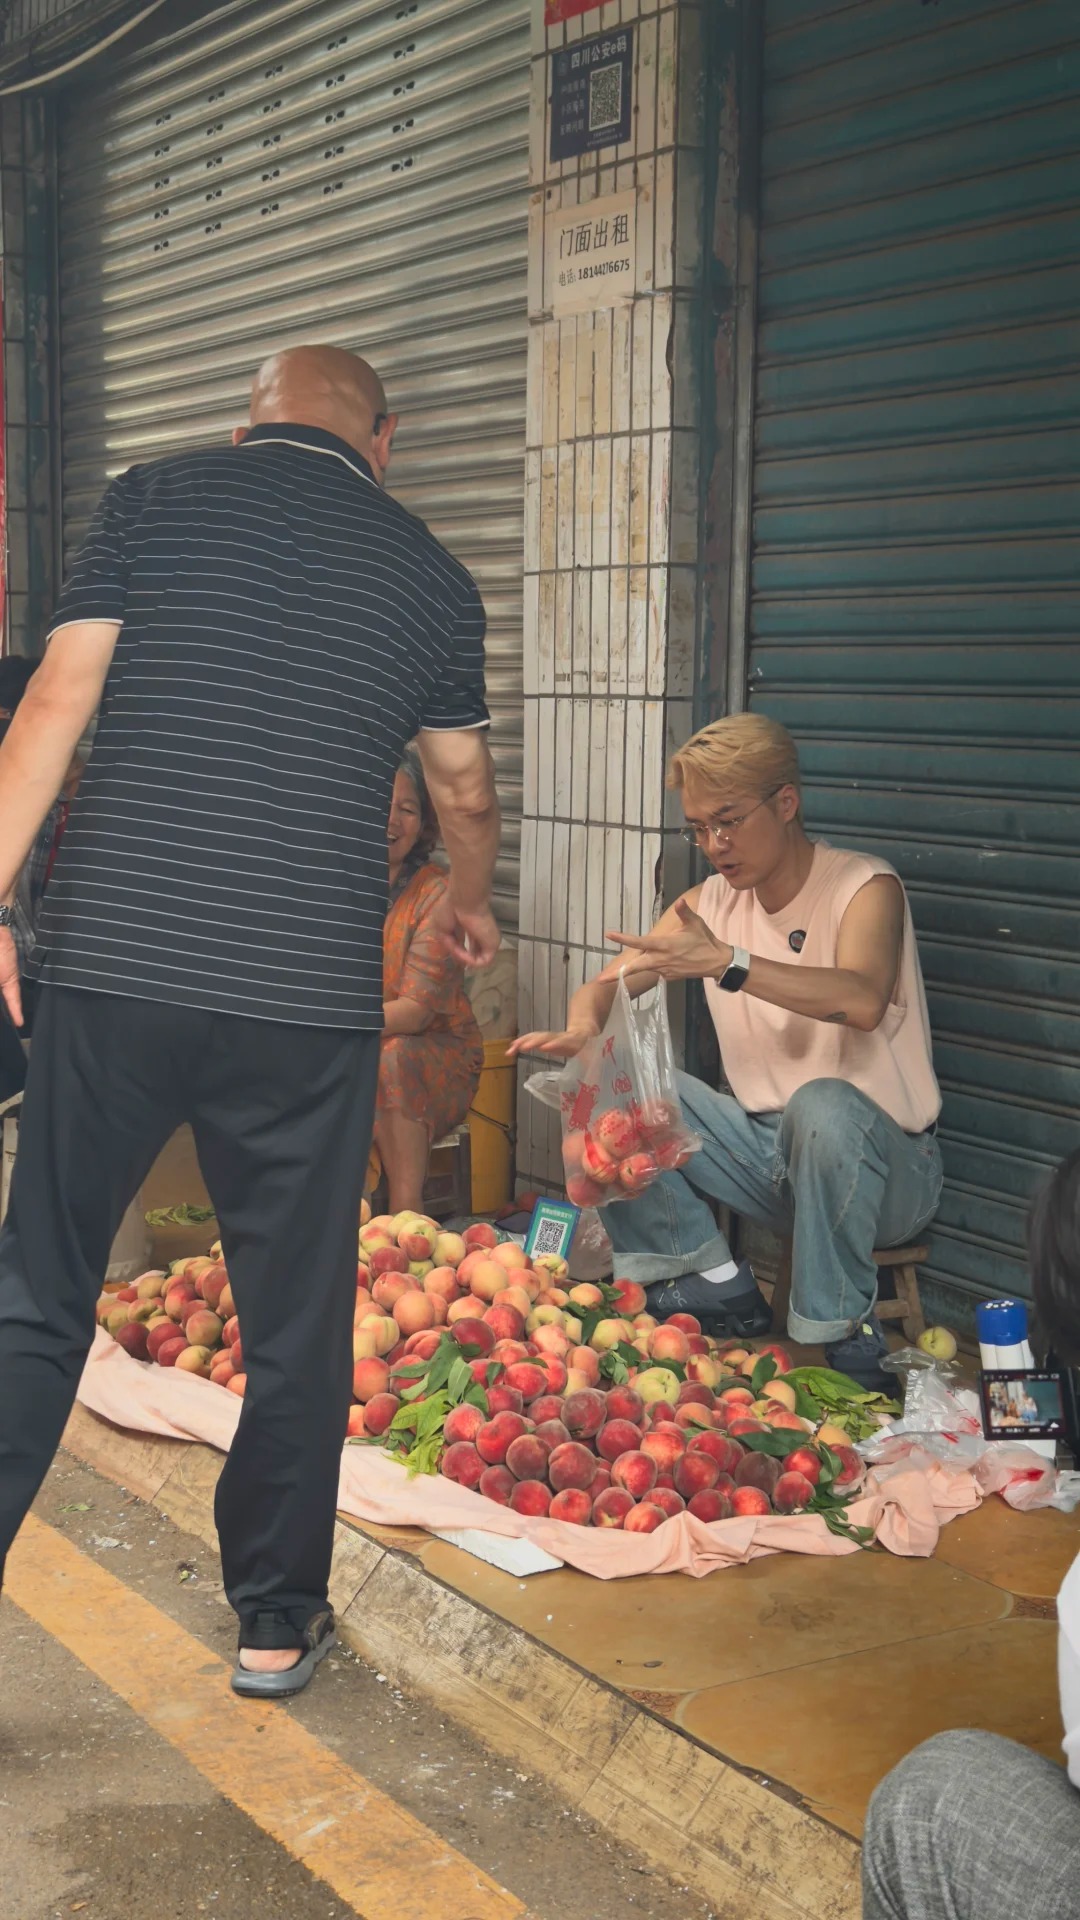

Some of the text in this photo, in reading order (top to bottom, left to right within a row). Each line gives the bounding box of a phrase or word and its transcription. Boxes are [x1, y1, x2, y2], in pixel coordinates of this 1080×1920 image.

[571, 35, 628, 69] 四川公安e码
[560, 213, 629, 260] 门面出租
